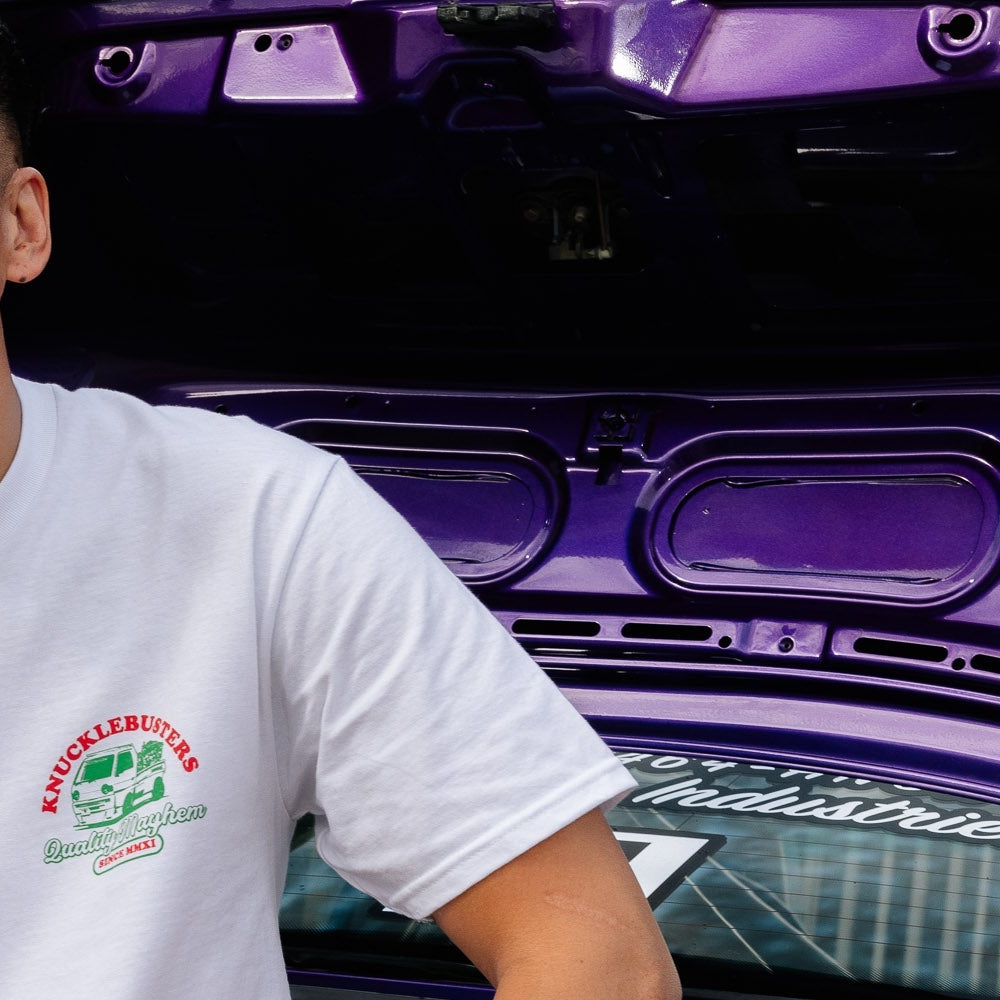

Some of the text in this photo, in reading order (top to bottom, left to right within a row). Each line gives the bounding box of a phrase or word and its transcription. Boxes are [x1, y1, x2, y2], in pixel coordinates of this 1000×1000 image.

[42, 715, 199, 814] KNUCKLEBUSTERS
[43, 802, 207, 864] Quality Mayhem
[99, 838, 156, 868] SINCE MMXI
